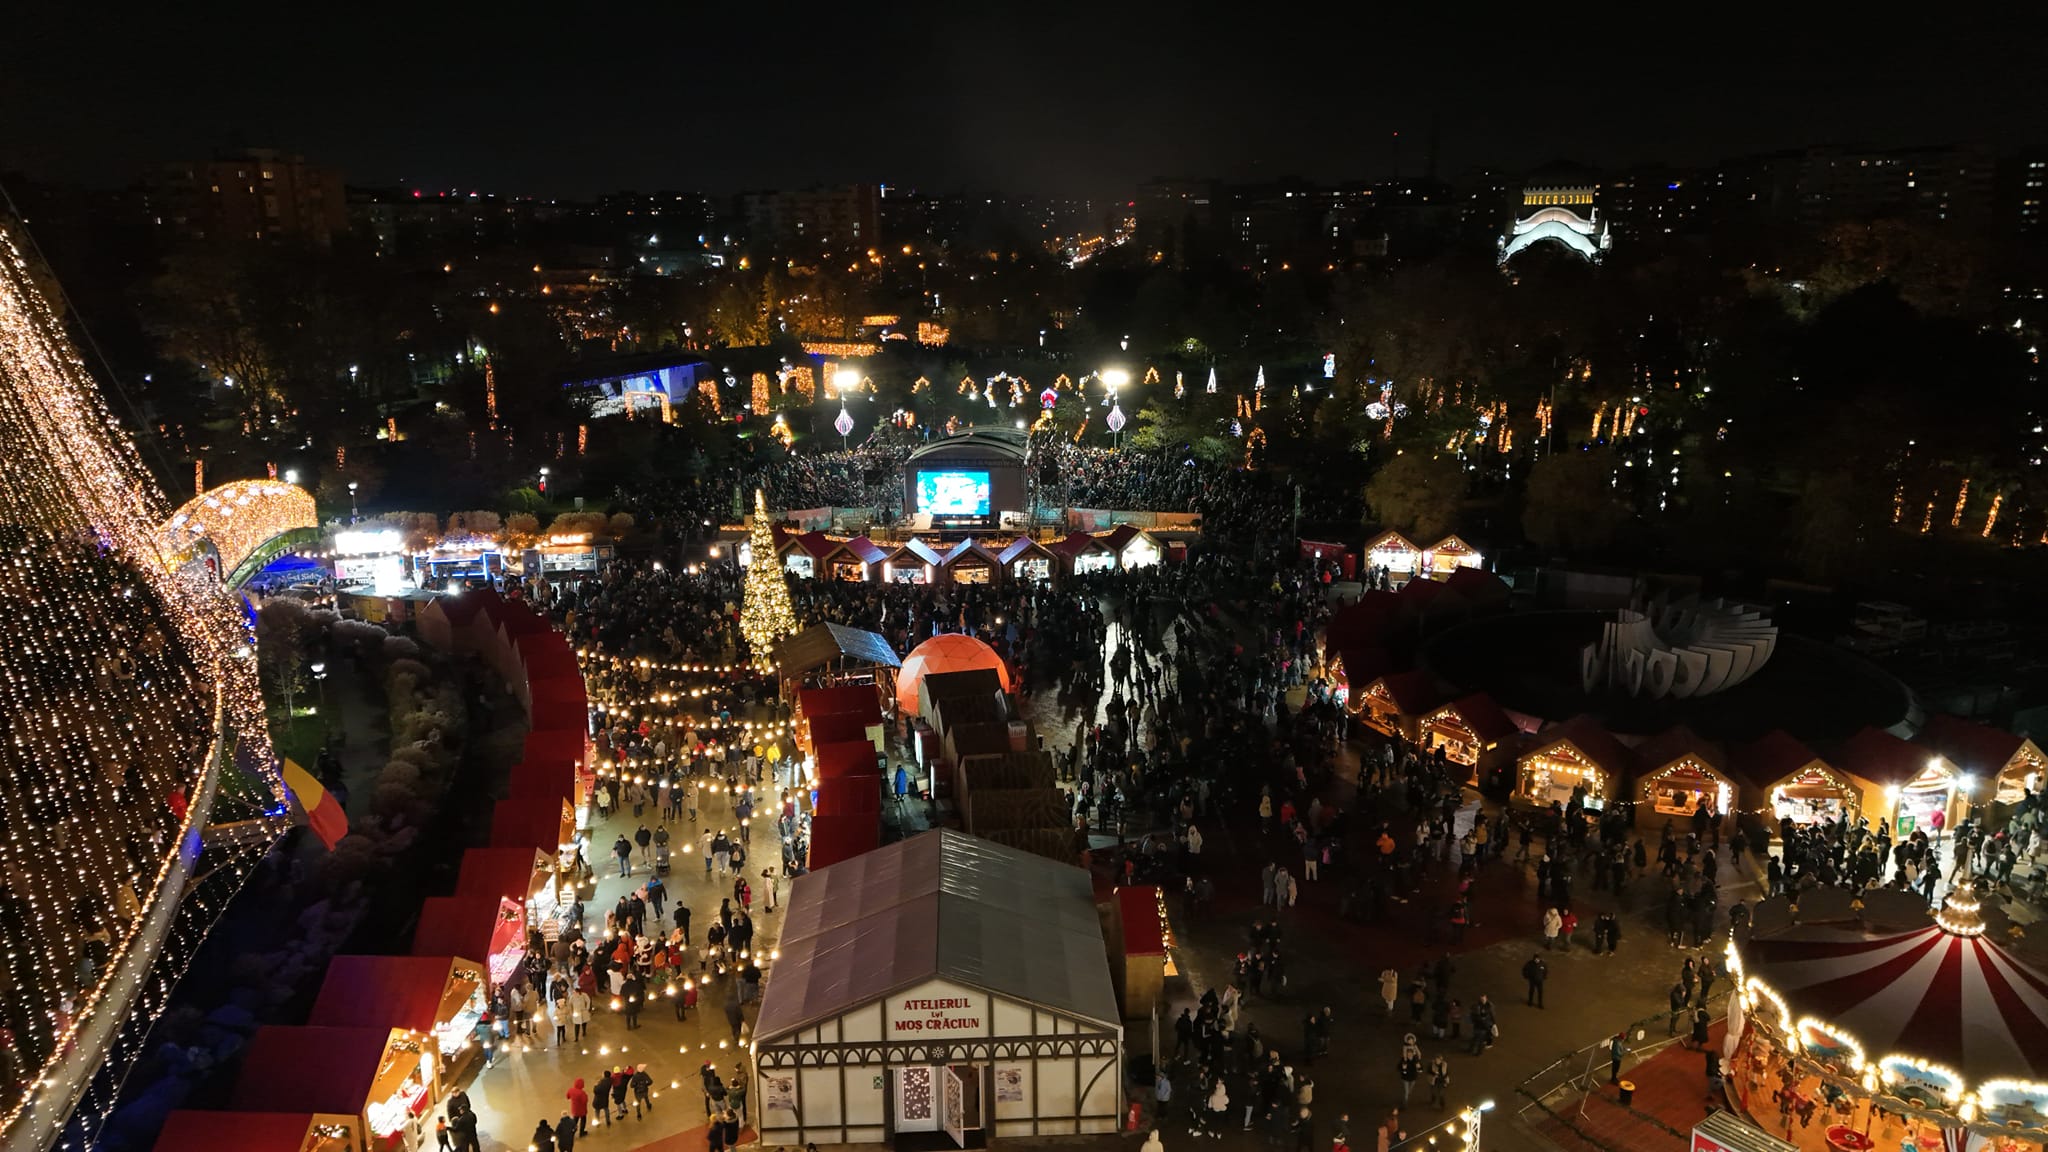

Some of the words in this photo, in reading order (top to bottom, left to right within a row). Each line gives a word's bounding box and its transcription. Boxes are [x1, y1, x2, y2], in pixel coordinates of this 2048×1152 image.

[904, 998, 971, 1010] ATELIERUL
[895, 1020, 922, 1033] MOȘ
[926, 1018, 979, 1030] CRĂCIUN
